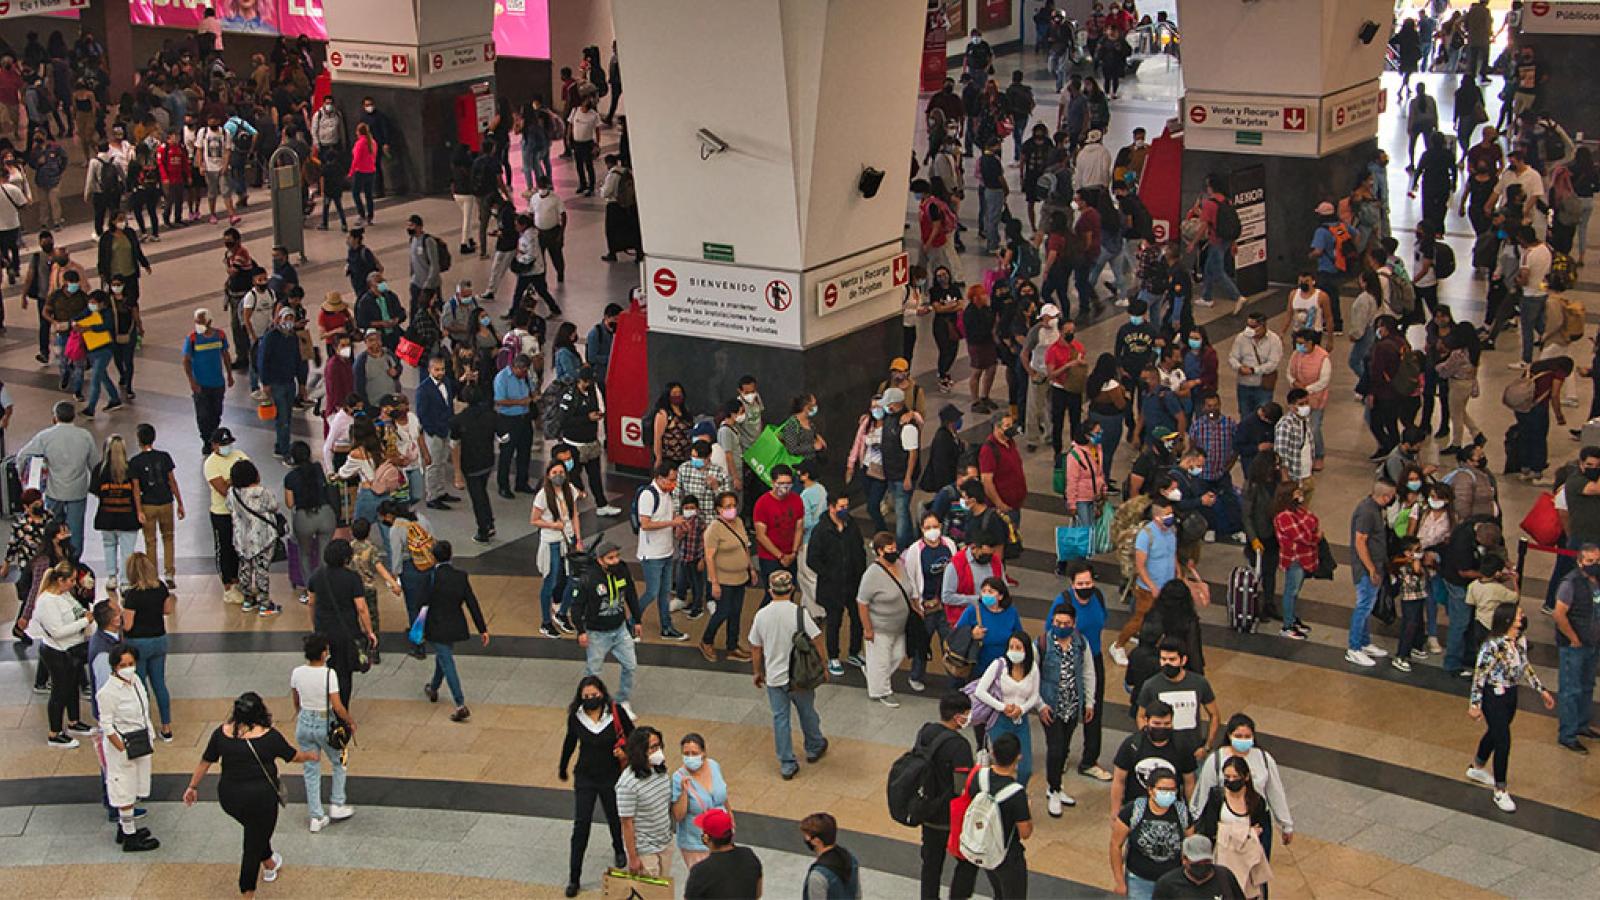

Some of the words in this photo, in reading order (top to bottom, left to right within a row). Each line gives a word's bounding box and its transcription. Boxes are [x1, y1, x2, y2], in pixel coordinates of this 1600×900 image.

[1211, 106, 1235, 114] Venta
[1244, 106, 1280, 117] Recarga
[1222, 117, 1233, 125] de
[1235, 117, 1268, 127] Tarjetas
[690, 277, 756, 292] BIENVENIDO
